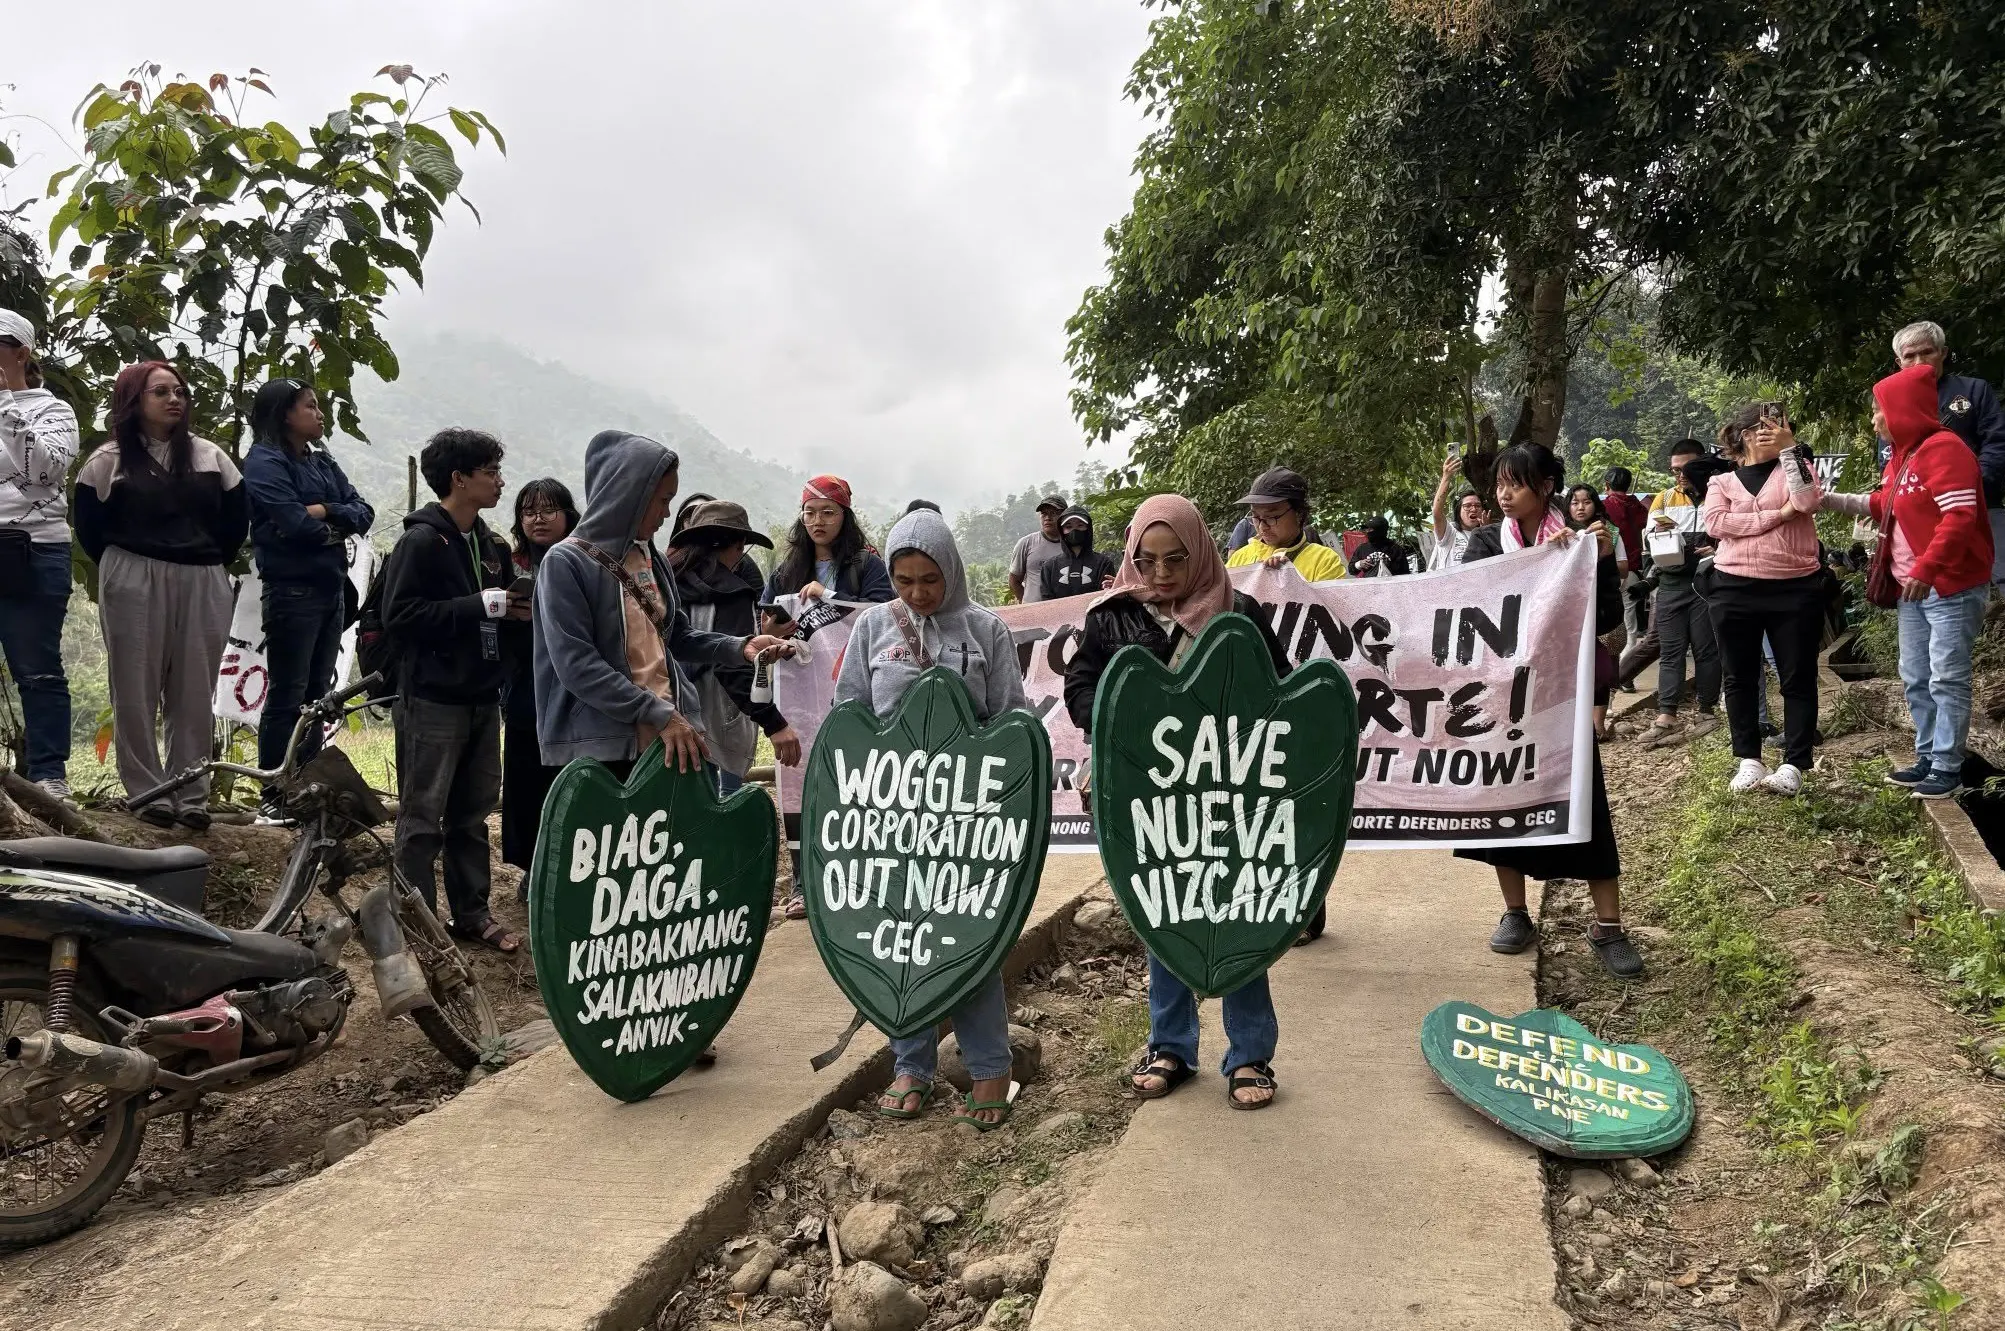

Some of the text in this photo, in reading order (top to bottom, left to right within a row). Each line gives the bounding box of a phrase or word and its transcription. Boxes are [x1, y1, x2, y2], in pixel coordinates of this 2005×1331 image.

[1432, 594, 1522, 667] IN
[1356, 666, 1531, 741] RTE!
[834, 748, 1007, 814] WOGGLE
[1148, 714, 1291, 789] SAVE
[1411, 743, 1536, 787] NOW!
[569, 808, 684, 883] BIAG,
[821, 807, 1029, 863] CORPORATION
[1130, 790, 1297, 866] NUEVA
[1352, 815, 1396, 830] ORTE
[1398, 815, 1492, 832] DEFENDERS
[1524, 809, 1557, 827] CEC
[588, 857, 719, 937] DAGA,
[822, 857, 1010, 920] OUT NOW!
[1130, 859, 1319, 929] VIZCAYA!
[577, 953, 744, 1026] SALAKNIBAN!
[1452, 1038, 1671, 1112] DEFENDERS
[1456, 1012, 1651, 1076] DEFEND
[1495, 1073, 1630, 1120] KALIKASAN
[1533, 1098, 1592, 1126] PNE
